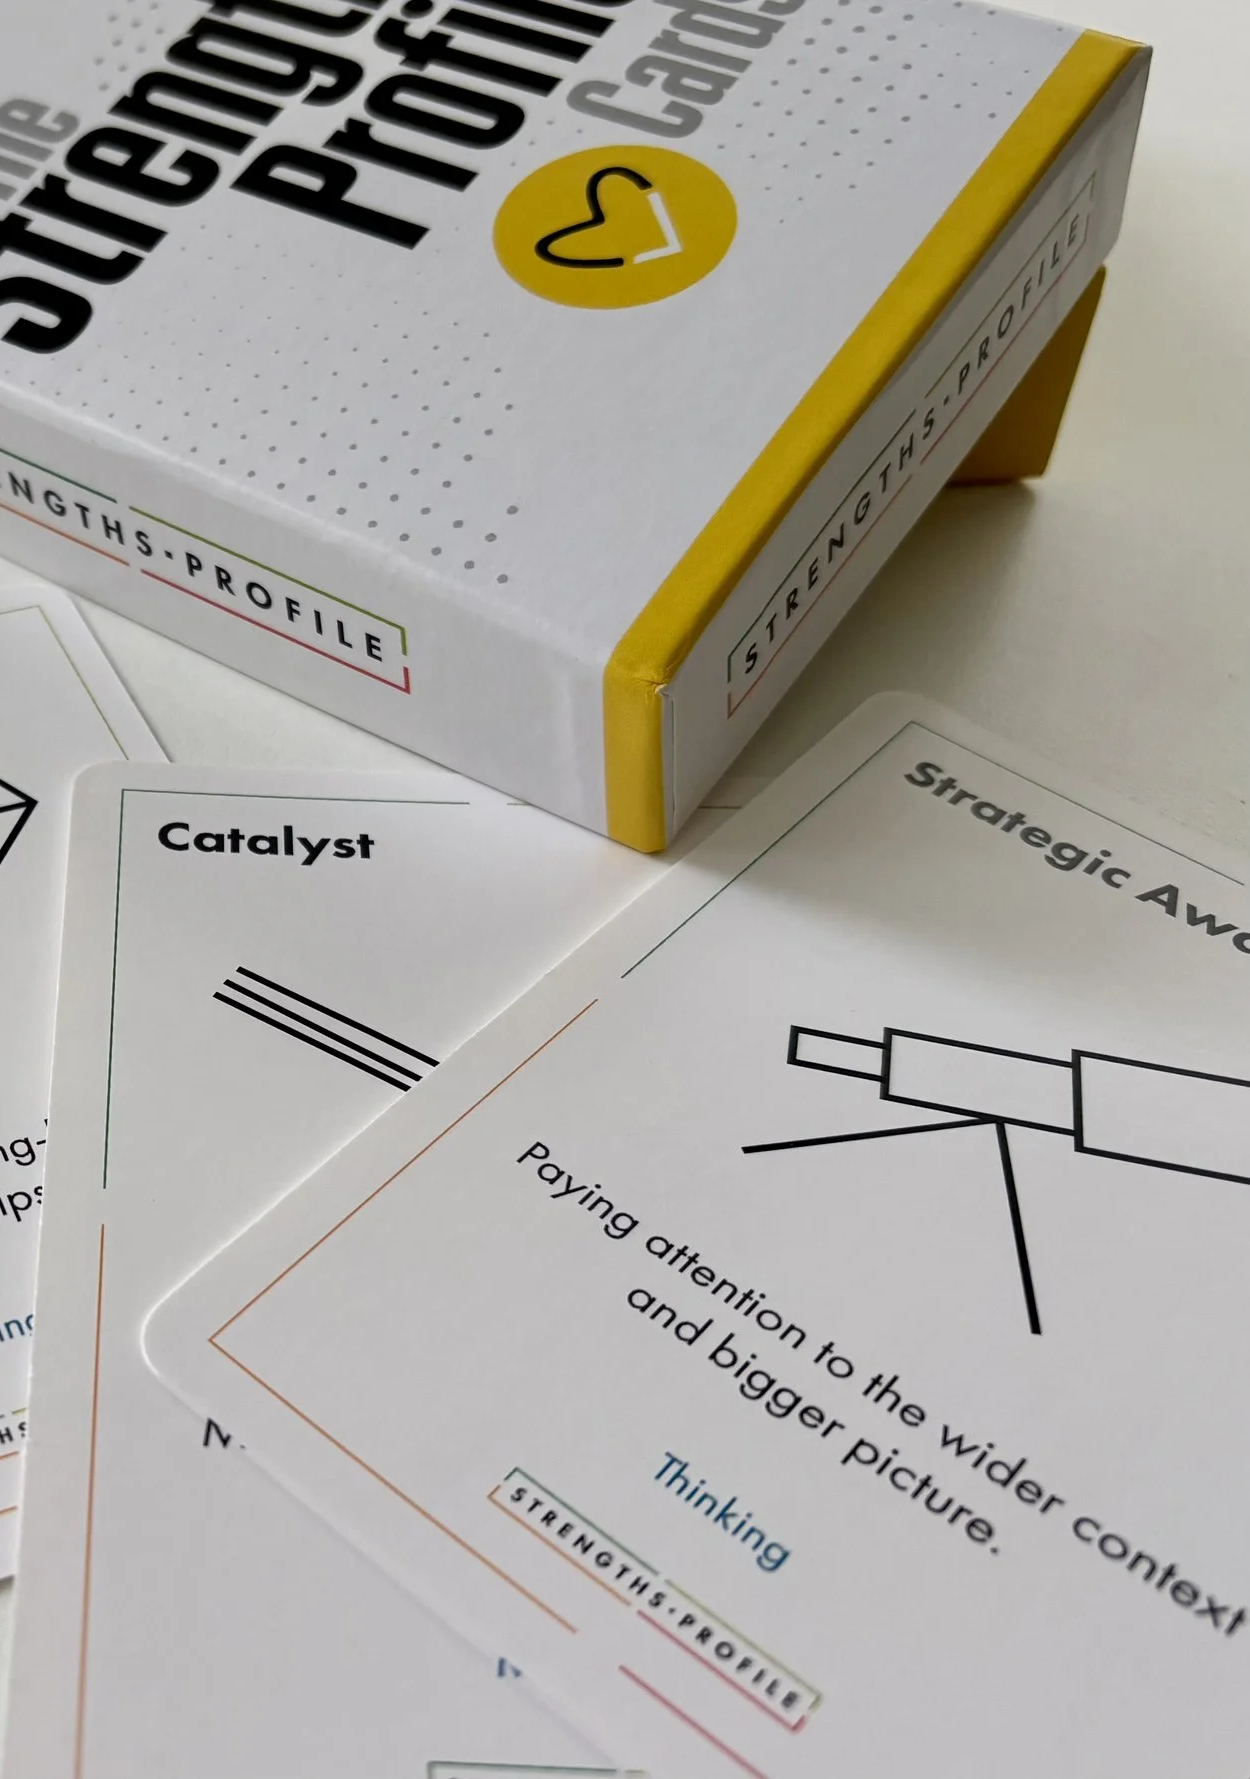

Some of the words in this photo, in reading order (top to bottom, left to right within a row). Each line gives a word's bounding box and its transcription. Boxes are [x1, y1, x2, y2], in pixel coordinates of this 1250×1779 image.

[230, 0, 634, 249] Profil
[157, 821, 375, 866] Catalyst
[903, 761, 1132, 889] Strategic
[516, 1140, 639, 1241] Paying
[644, 1231, 808, 1350] attention
[815, 1341, 855, 1380] to
[862, 1372, 927, 1427] the
[939, 1424, 1065, 1514] wider
[1072, 1517, 1246, 1636] context
[627, 1284, 715, 1347] and
[708, 1332, 847, 1439] bigger
[841, 1438, 999, 1555] picture.
[654, 1451, 791, 1573] Thinking
